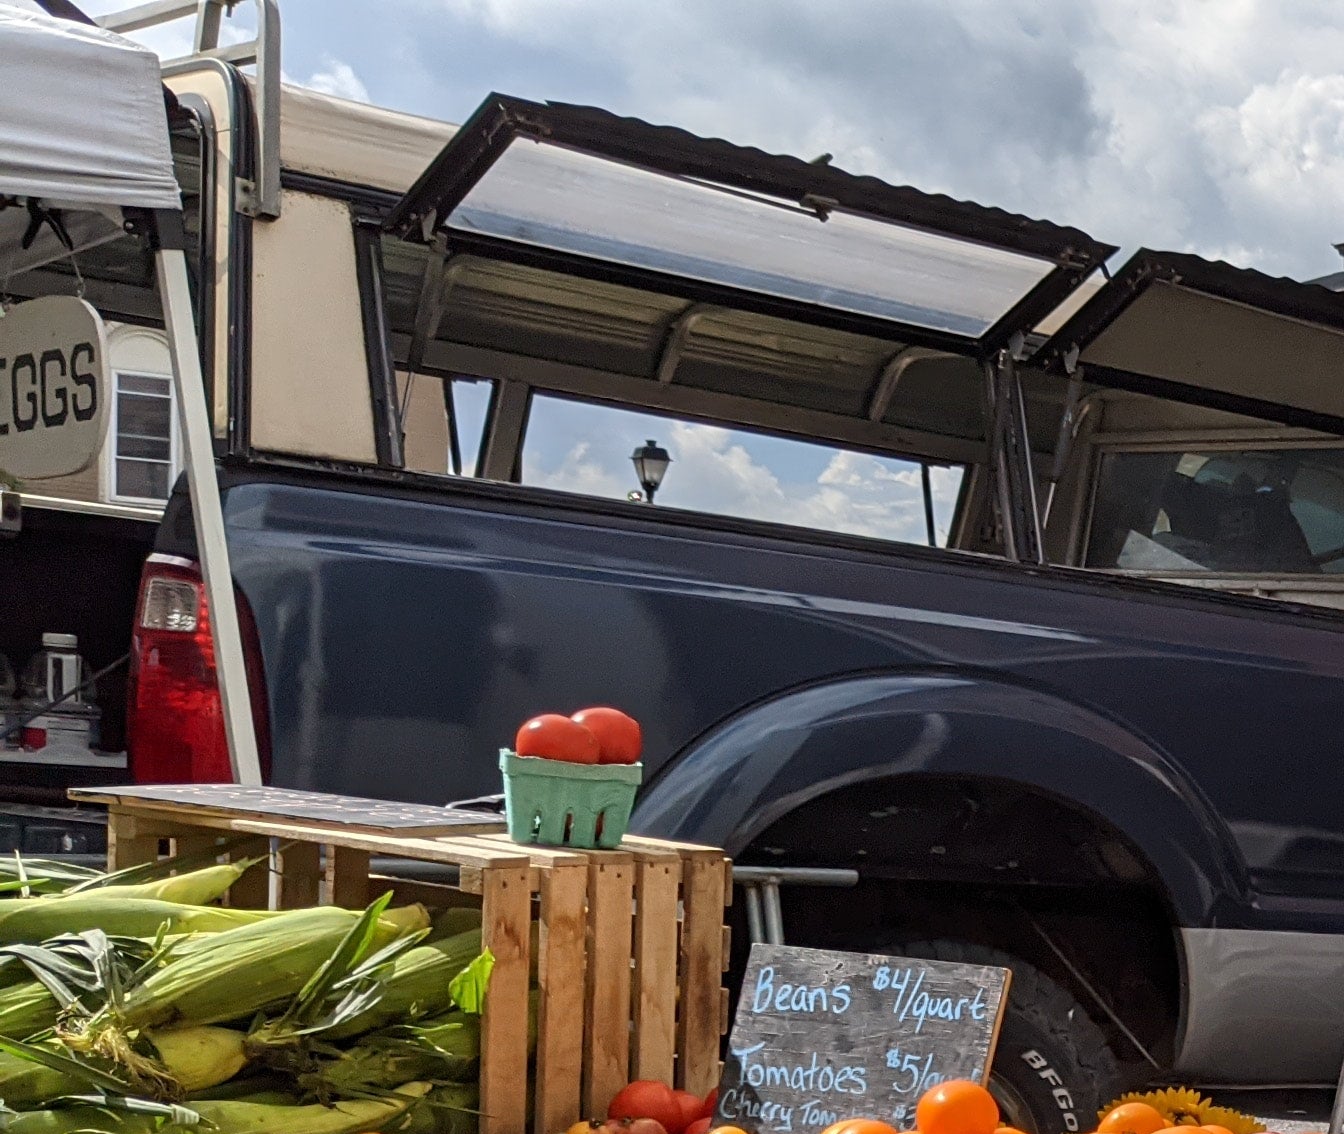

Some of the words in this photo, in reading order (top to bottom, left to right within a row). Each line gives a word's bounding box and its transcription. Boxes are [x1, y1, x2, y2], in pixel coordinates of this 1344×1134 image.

[752, 967, 852, 1014] Beans
[873, 966, 987, 1034] $4/quart
[731, 1042, 867, 1095] Tomatoes
[719, 1089, 794, 1131] Cherry
